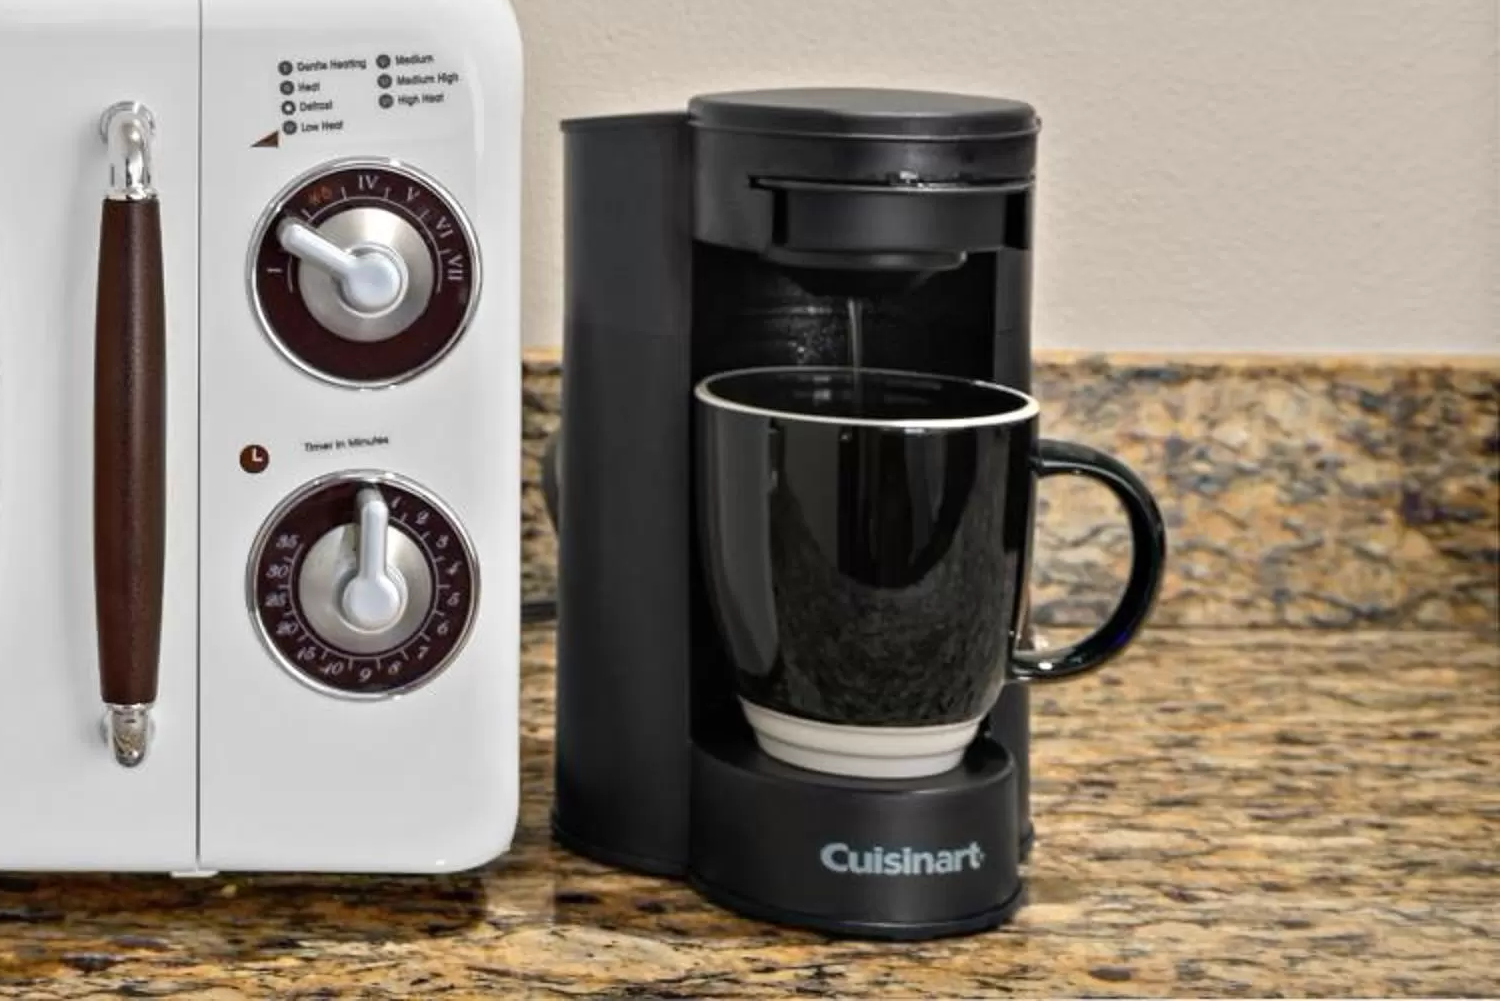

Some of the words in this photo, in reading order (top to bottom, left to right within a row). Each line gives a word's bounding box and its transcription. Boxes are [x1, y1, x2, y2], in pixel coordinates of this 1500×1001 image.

[330, 59, 367, 70] Heating
[395, 55, 434, 65] Medium
[397, 75, 435, 85] Medium
[437, 73, 459, 84] High
[398, 95, 420, 106] High
[301, 123, 319, 133] Low
[322, 121, 344, 131] Heat
[358, 175, 379, 191] IV
[820, 841, 981, 876] Cuisinart
